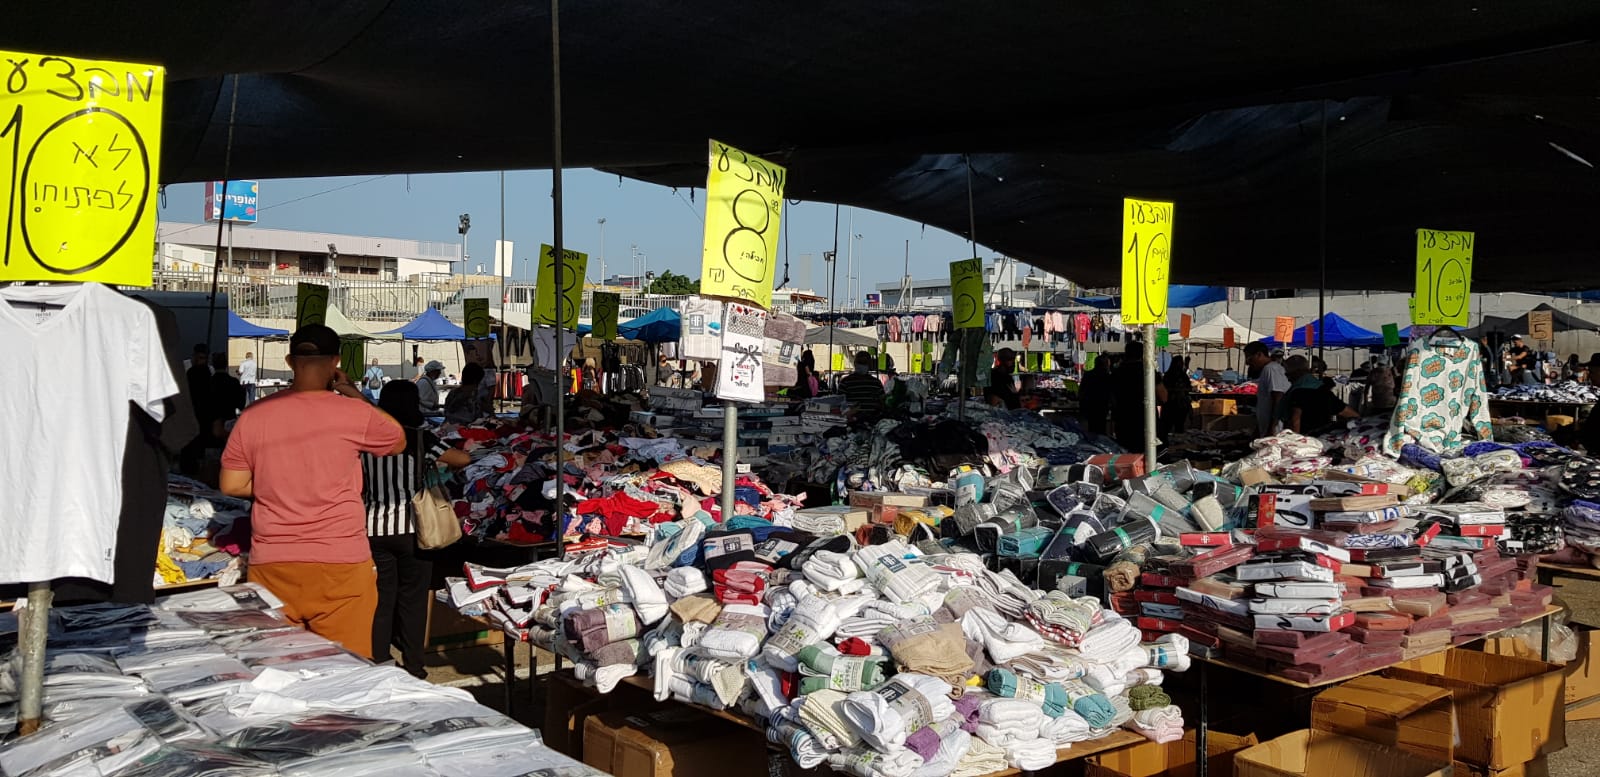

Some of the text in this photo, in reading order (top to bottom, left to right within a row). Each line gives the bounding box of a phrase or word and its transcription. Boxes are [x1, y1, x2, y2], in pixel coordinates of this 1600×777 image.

[7, 57, 154, 102] מבצע
[72, 133, 132, 171] לא
[718, 143, 783, 196] מבצע
[0, 104, 150, 275] 10
[723, 189, 769, 283] 8
[1128, 232, 1168, 320] 10
[1422, 257, 1466, 318] 10
[1534, 323, 1547, 340] 5
